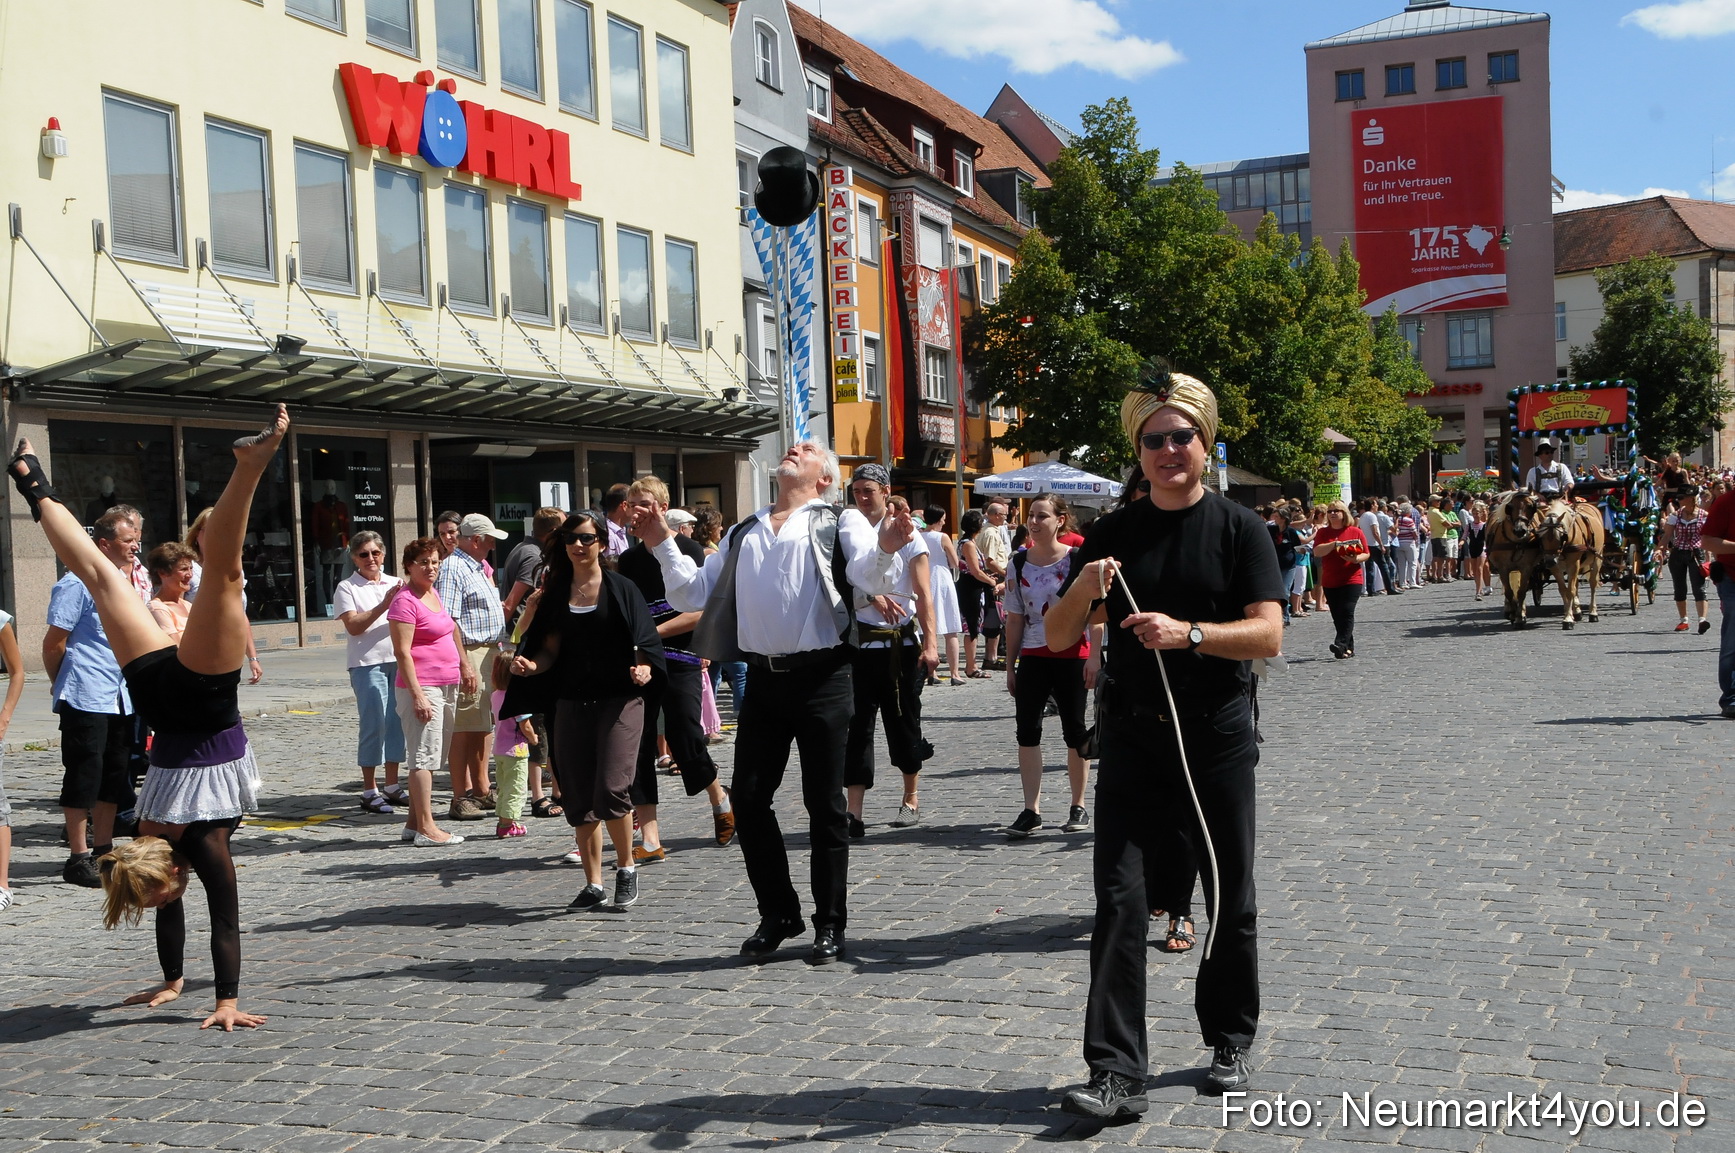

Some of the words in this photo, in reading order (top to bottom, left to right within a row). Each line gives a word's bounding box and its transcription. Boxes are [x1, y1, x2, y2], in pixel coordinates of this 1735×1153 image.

[338, 62, 582, 201] WÖHRL
[1363, 155, 1417, 174] Danke
[1363, 181, 1379, 191] für
[1381, 179, 1396, 190] Ihr
[1398, 176, 1452, 188] Vertrauen
[1364, 194, 1385, 206] und
[1387, 193, 1409, 203] Ihre
[1410, 191, 1444, 201] Treue.
[1409, 225, 1460, 248] 175
[830, 168, 851, 353] BÄCKEREI
[1411, 246, 1460, 261] JAHRE
[1411, 265, 1440, 273] Sparkasse
[835, 361, 857, 375] café
[836, 387, 858, 400] plank
[1542, 406, 1600, 422] Sambesi
[983, 481, 1008, 489] Winkler
[1051, 482, 1077, 490] Winkler
[499, 504, 527, 520] Aktion
